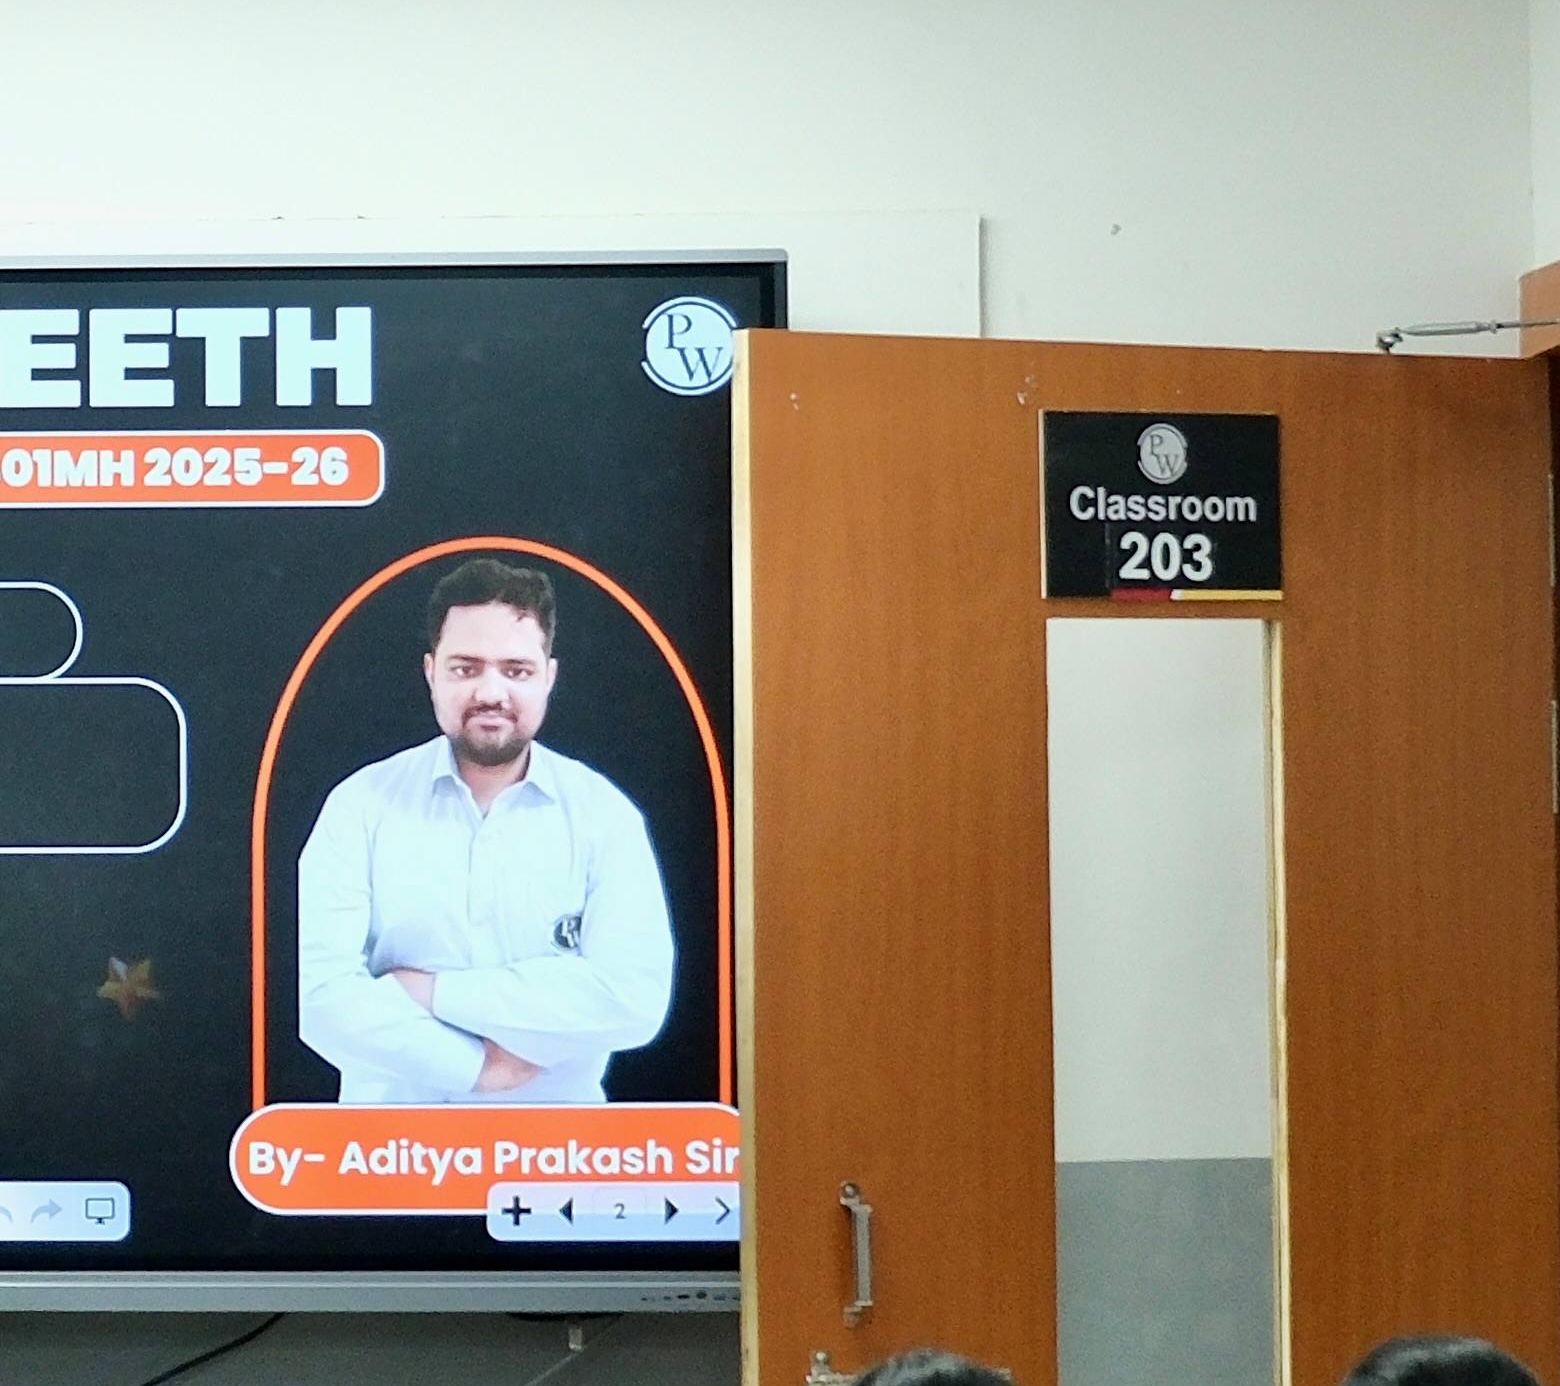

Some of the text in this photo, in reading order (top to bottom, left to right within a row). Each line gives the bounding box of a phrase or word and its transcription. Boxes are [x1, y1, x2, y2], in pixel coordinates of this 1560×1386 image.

[145, 449, 349, 487] 2025-26
[1069, 485, 1257, 522] Classroom
[1118, 531, 1213, 582] 203
[248, 1139, 740, 1187] By- Aditya Prakash Sir
[613, 1203, 626, 1220] 2
